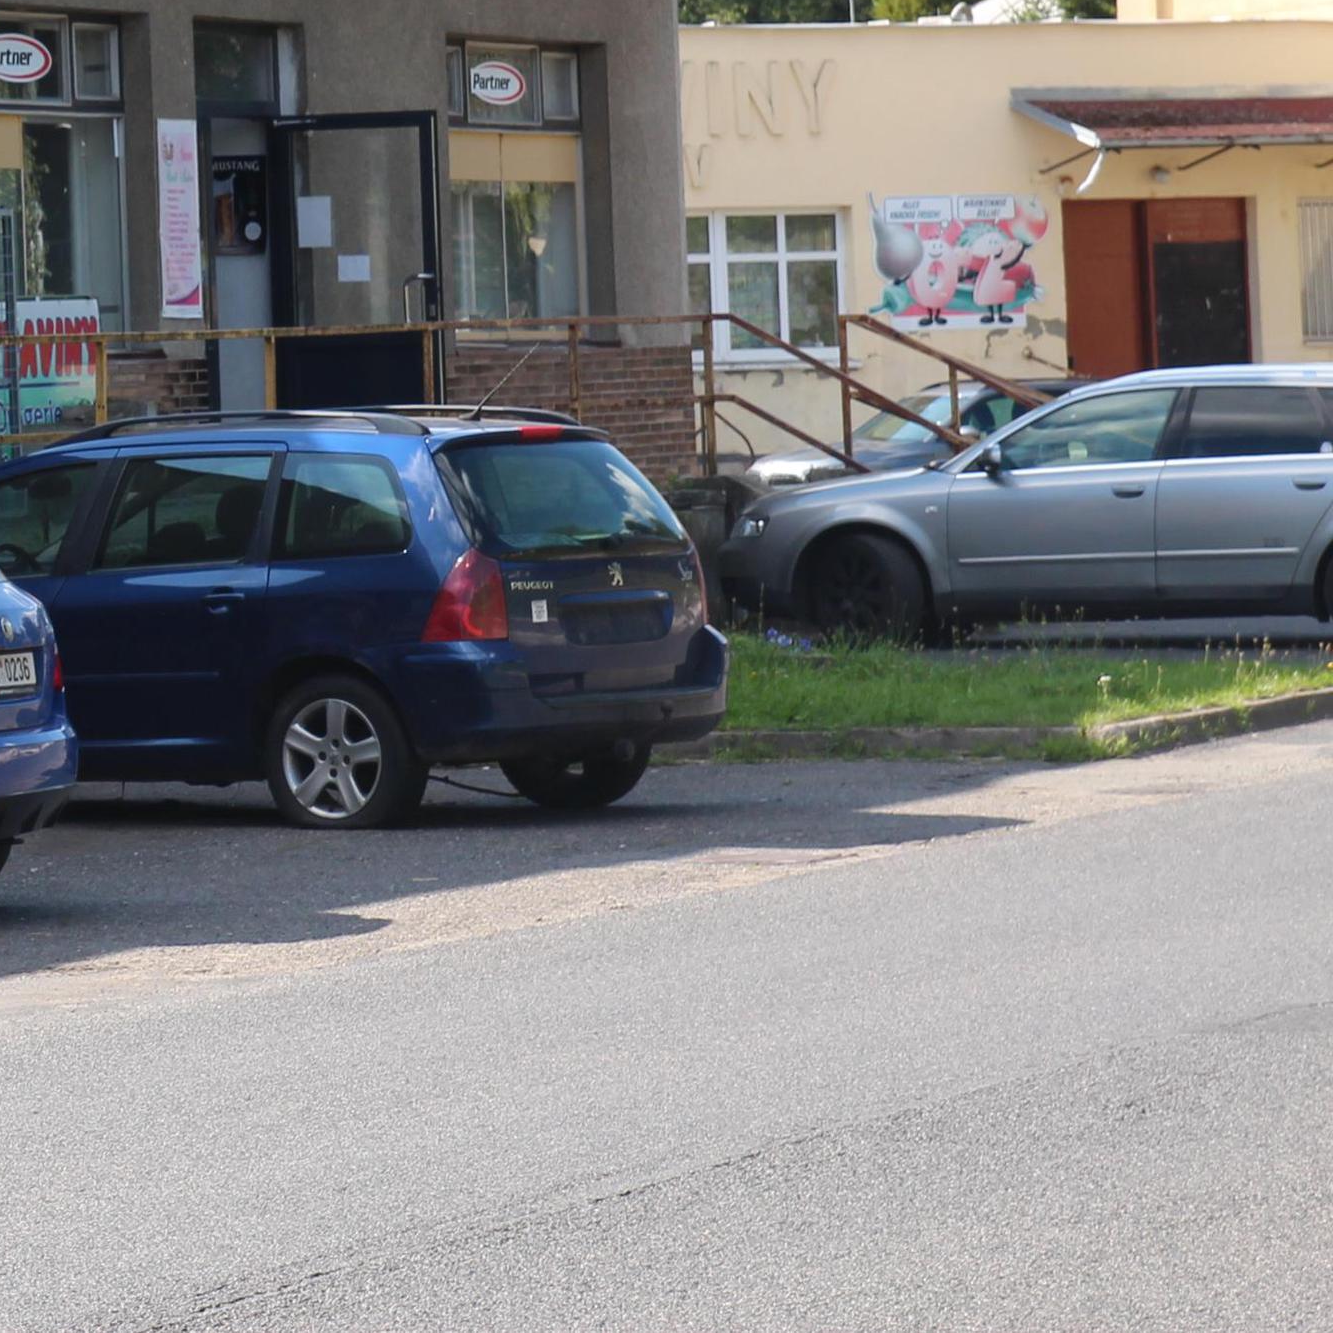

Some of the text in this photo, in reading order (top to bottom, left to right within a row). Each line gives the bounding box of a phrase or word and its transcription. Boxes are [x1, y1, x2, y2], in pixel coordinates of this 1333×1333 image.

[473, 73, 511, 91] Partner
[510, 581, 554, 591] PEUGEOT
[4, 657, 31, 682] 0236
